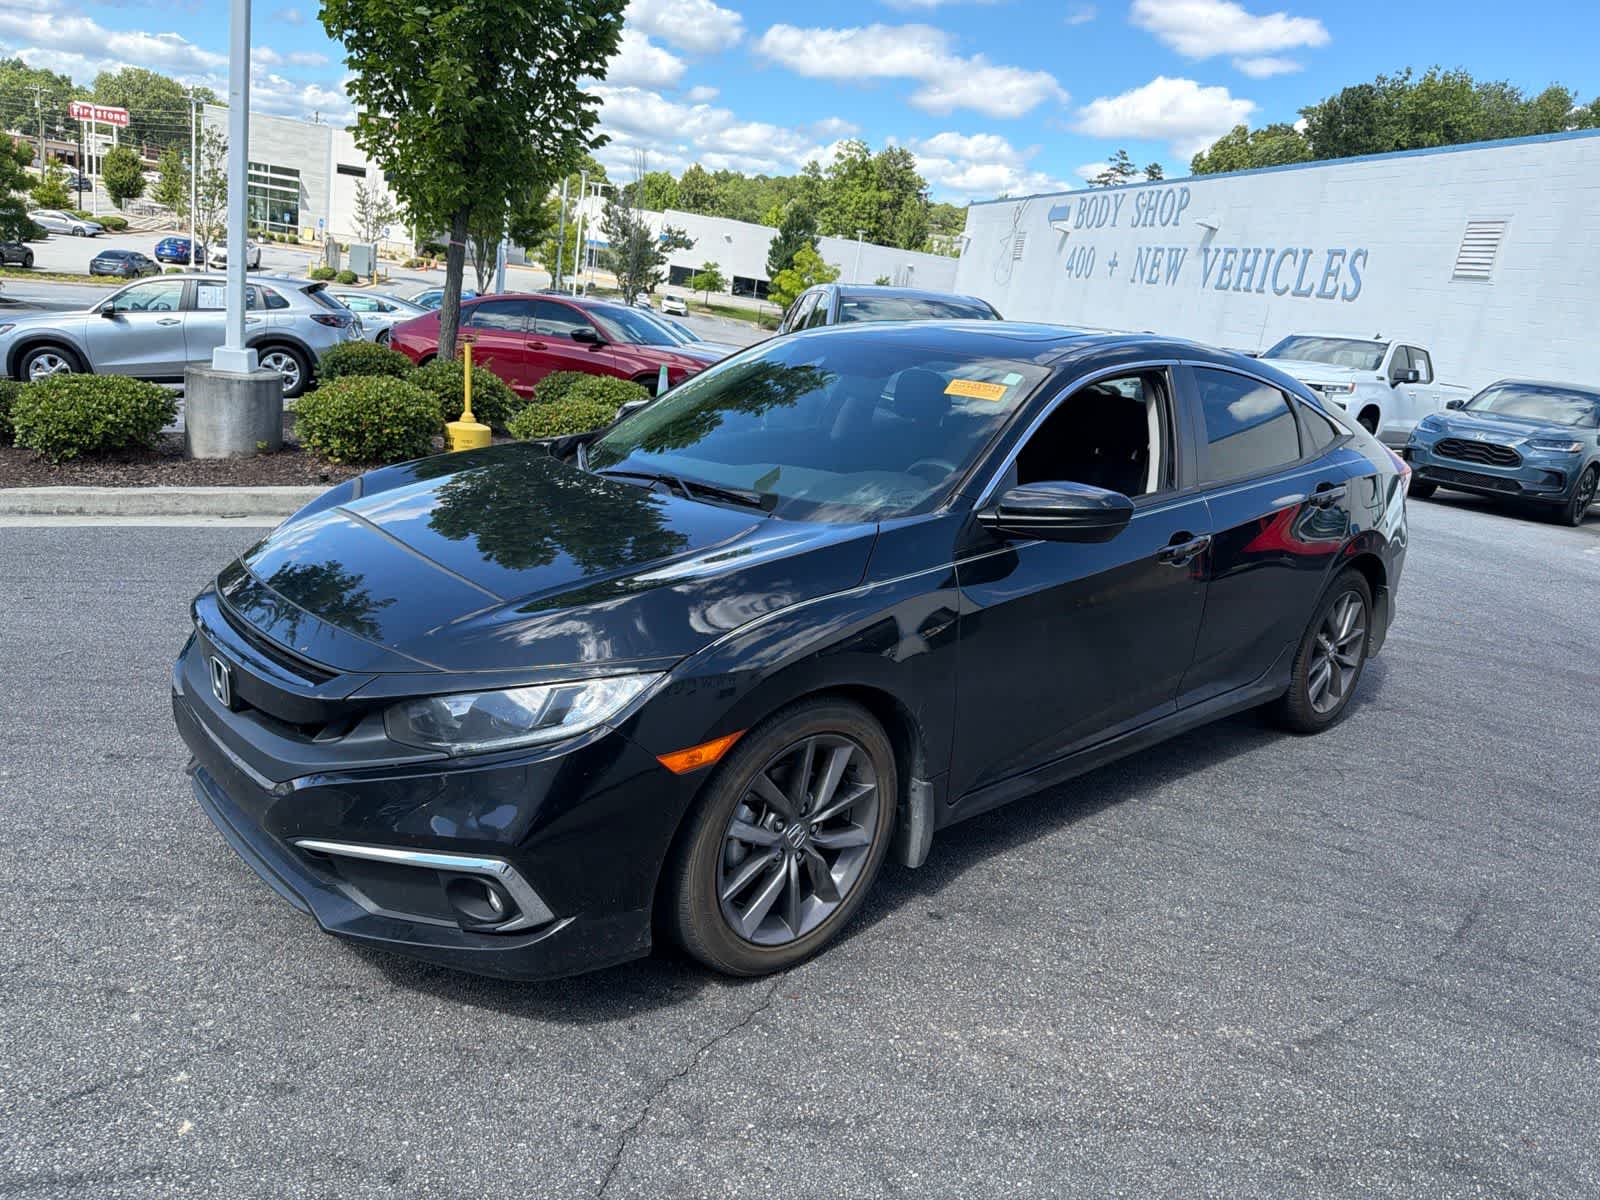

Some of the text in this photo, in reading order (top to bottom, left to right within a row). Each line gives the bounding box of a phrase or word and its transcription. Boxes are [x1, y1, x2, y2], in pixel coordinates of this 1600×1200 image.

[1073, 187, 1191, 229] BODY SHOP
[1066, 246, 1096, 279] 400
[1130, 247, 1188, 286] NEW
[1200, 248, 1368, 302] VEHICLES
